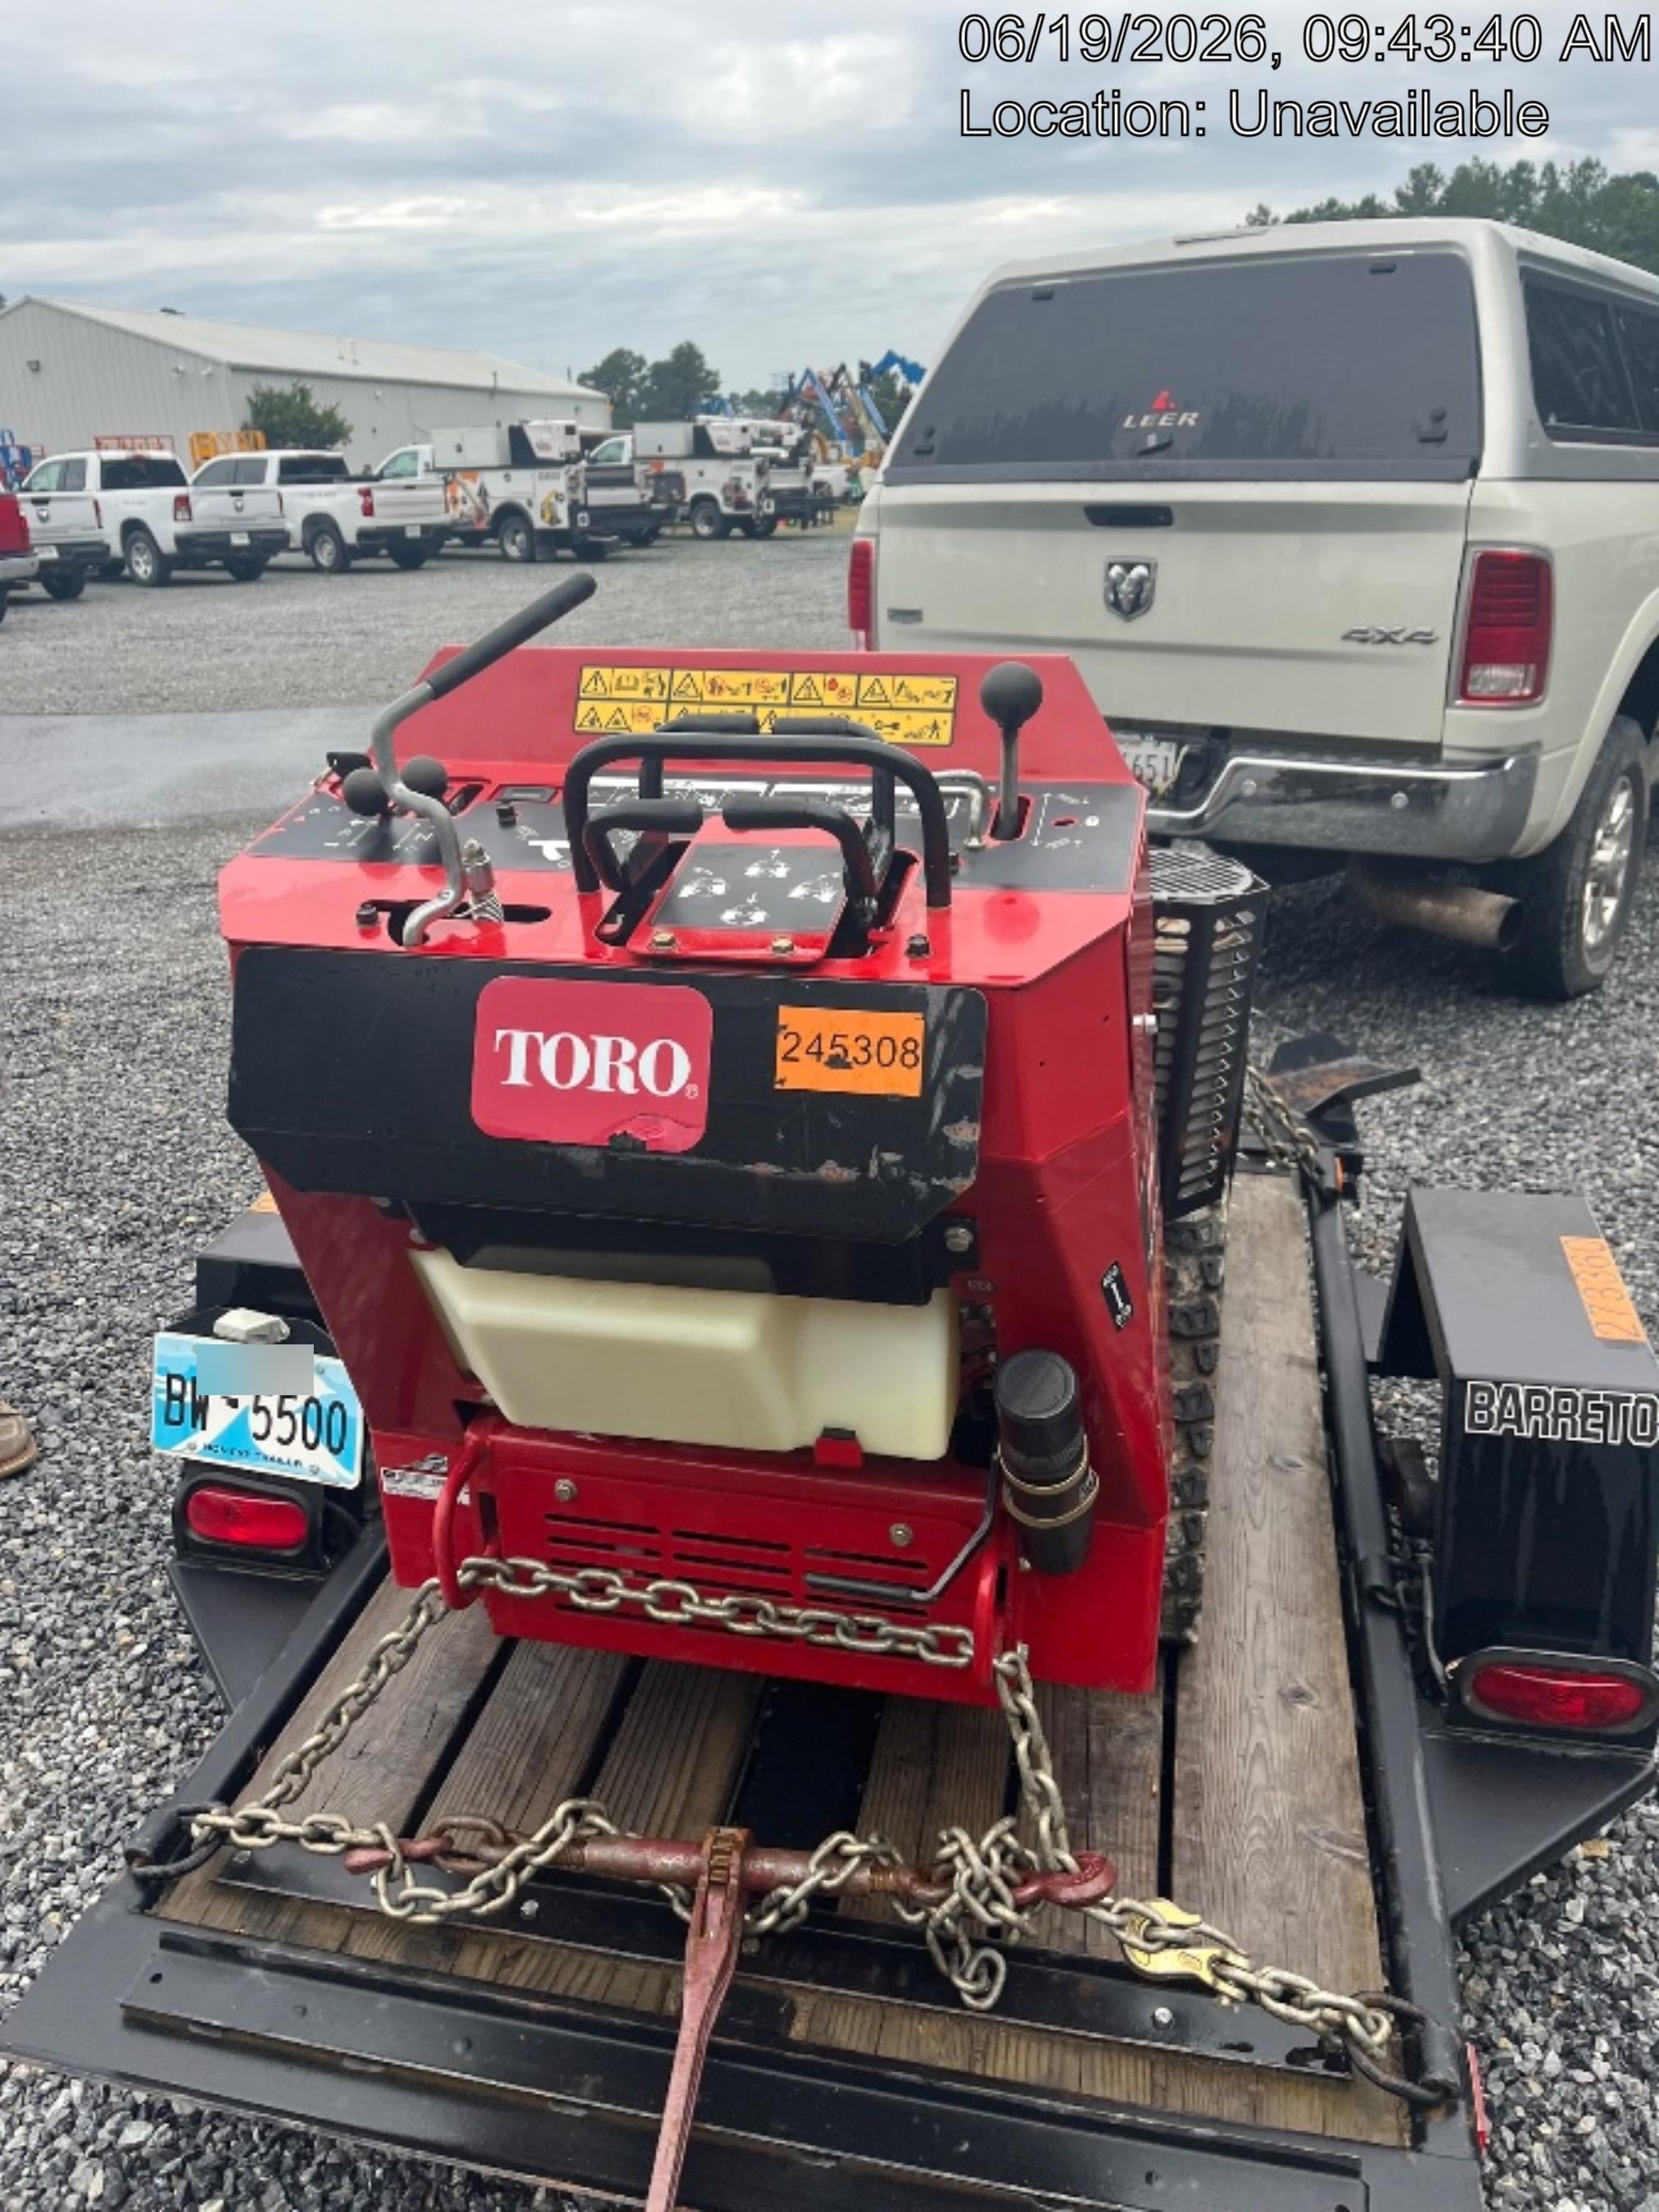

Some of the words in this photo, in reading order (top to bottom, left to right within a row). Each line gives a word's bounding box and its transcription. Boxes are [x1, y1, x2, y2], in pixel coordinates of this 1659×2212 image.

[1122, 412, 1199, 428] LEER
[1123, 754, 1169, 782] 651
[781, 1031, 920, 1069] 245308
[252, 1395, 347, 1456] 5500
[1466, 1381, 1659, 1446] BARRETO
